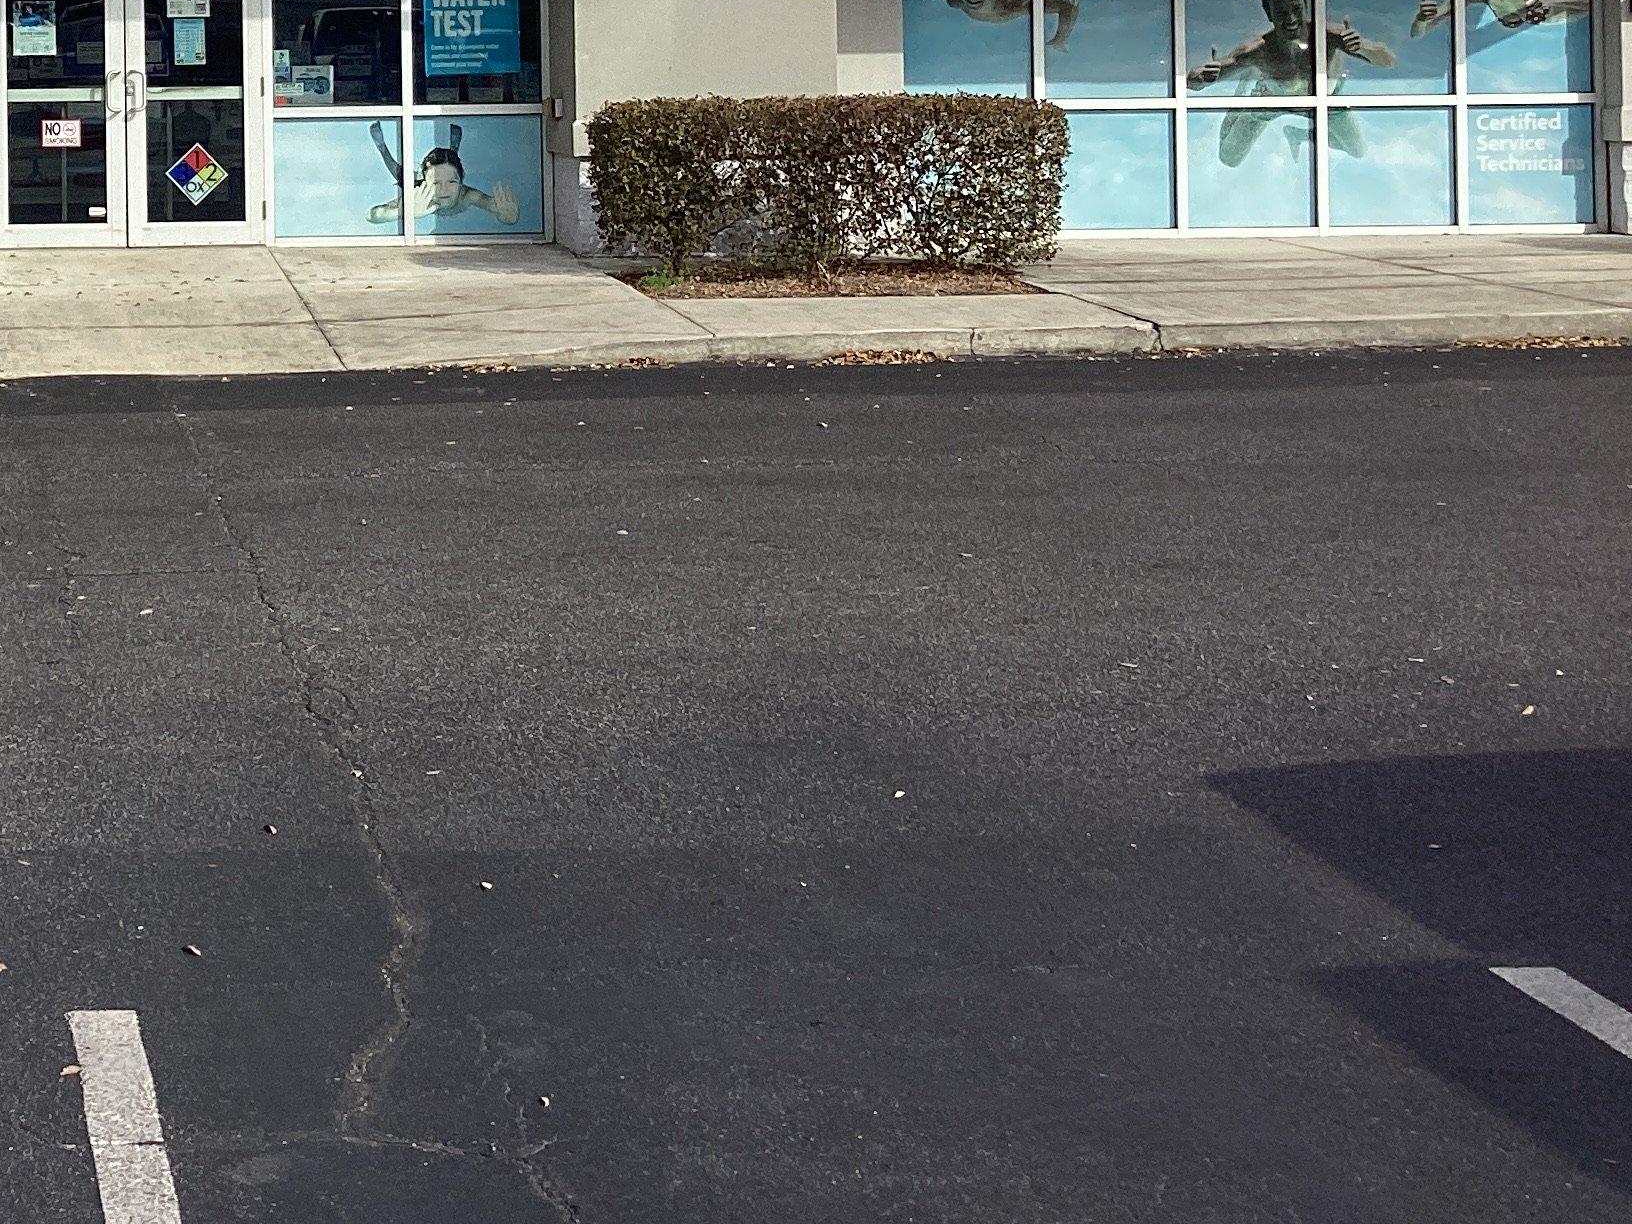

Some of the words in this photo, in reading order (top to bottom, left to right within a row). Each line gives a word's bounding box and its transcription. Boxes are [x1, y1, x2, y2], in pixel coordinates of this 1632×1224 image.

[430, 9, 484, 37] TEST
[45, 122, 61, 136] NO
[1475, 111, 1562, 131] Certified
[44, 137, 78, 145] SMOKING
[1475, 133, 1547, 152] Service
[194, 150, 200, 169] 1
[1475, 153, 1586, 172] Technicians
[205, 162, 217, 181] 2
